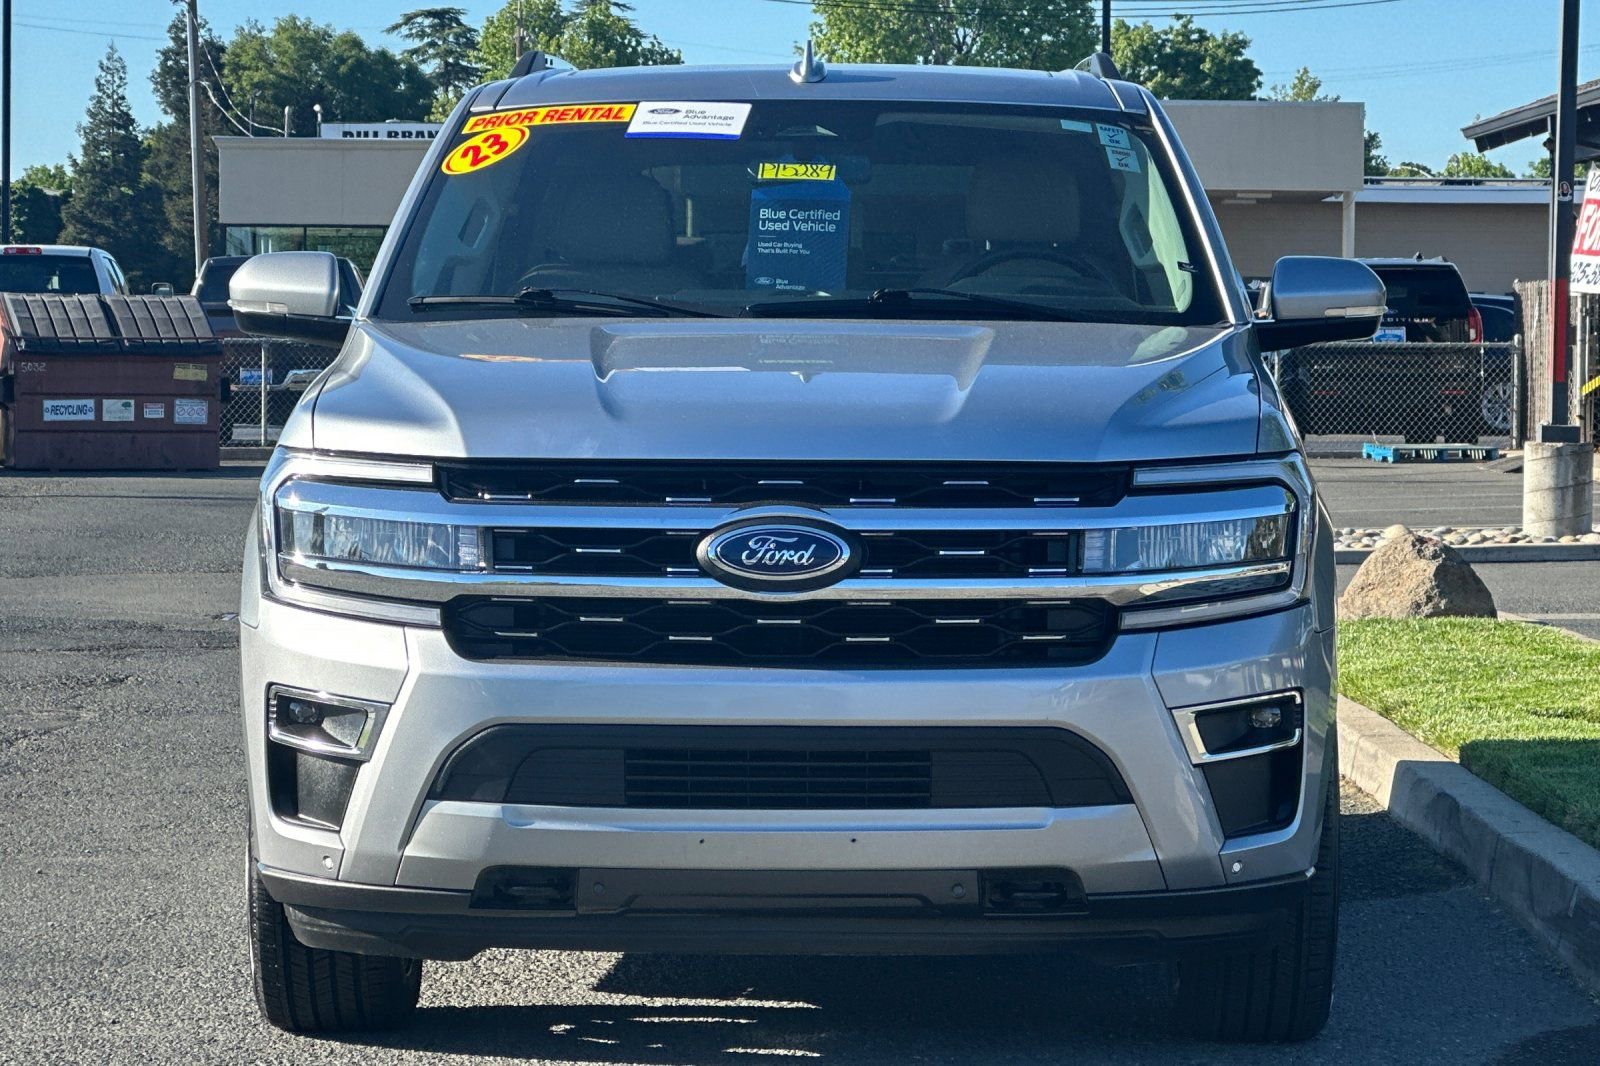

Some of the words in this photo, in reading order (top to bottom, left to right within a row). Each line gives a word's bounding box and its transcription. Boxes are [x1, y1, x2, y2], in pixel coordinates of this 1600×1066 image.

[469, 110, 539, 130] PRIOR
[541, 106, 625, 122] RENTAL
[461, 133, 508, 167] 23
[759, 208, 786, 219] Blue
[789, 208, 840, 220] Certified
[759, 220, 789, 231] Used
[793, 220, 836, 232] Vehicle
[50, 404, 88, 416] RECYCLING
[741, 535, 817, 566] Ford
